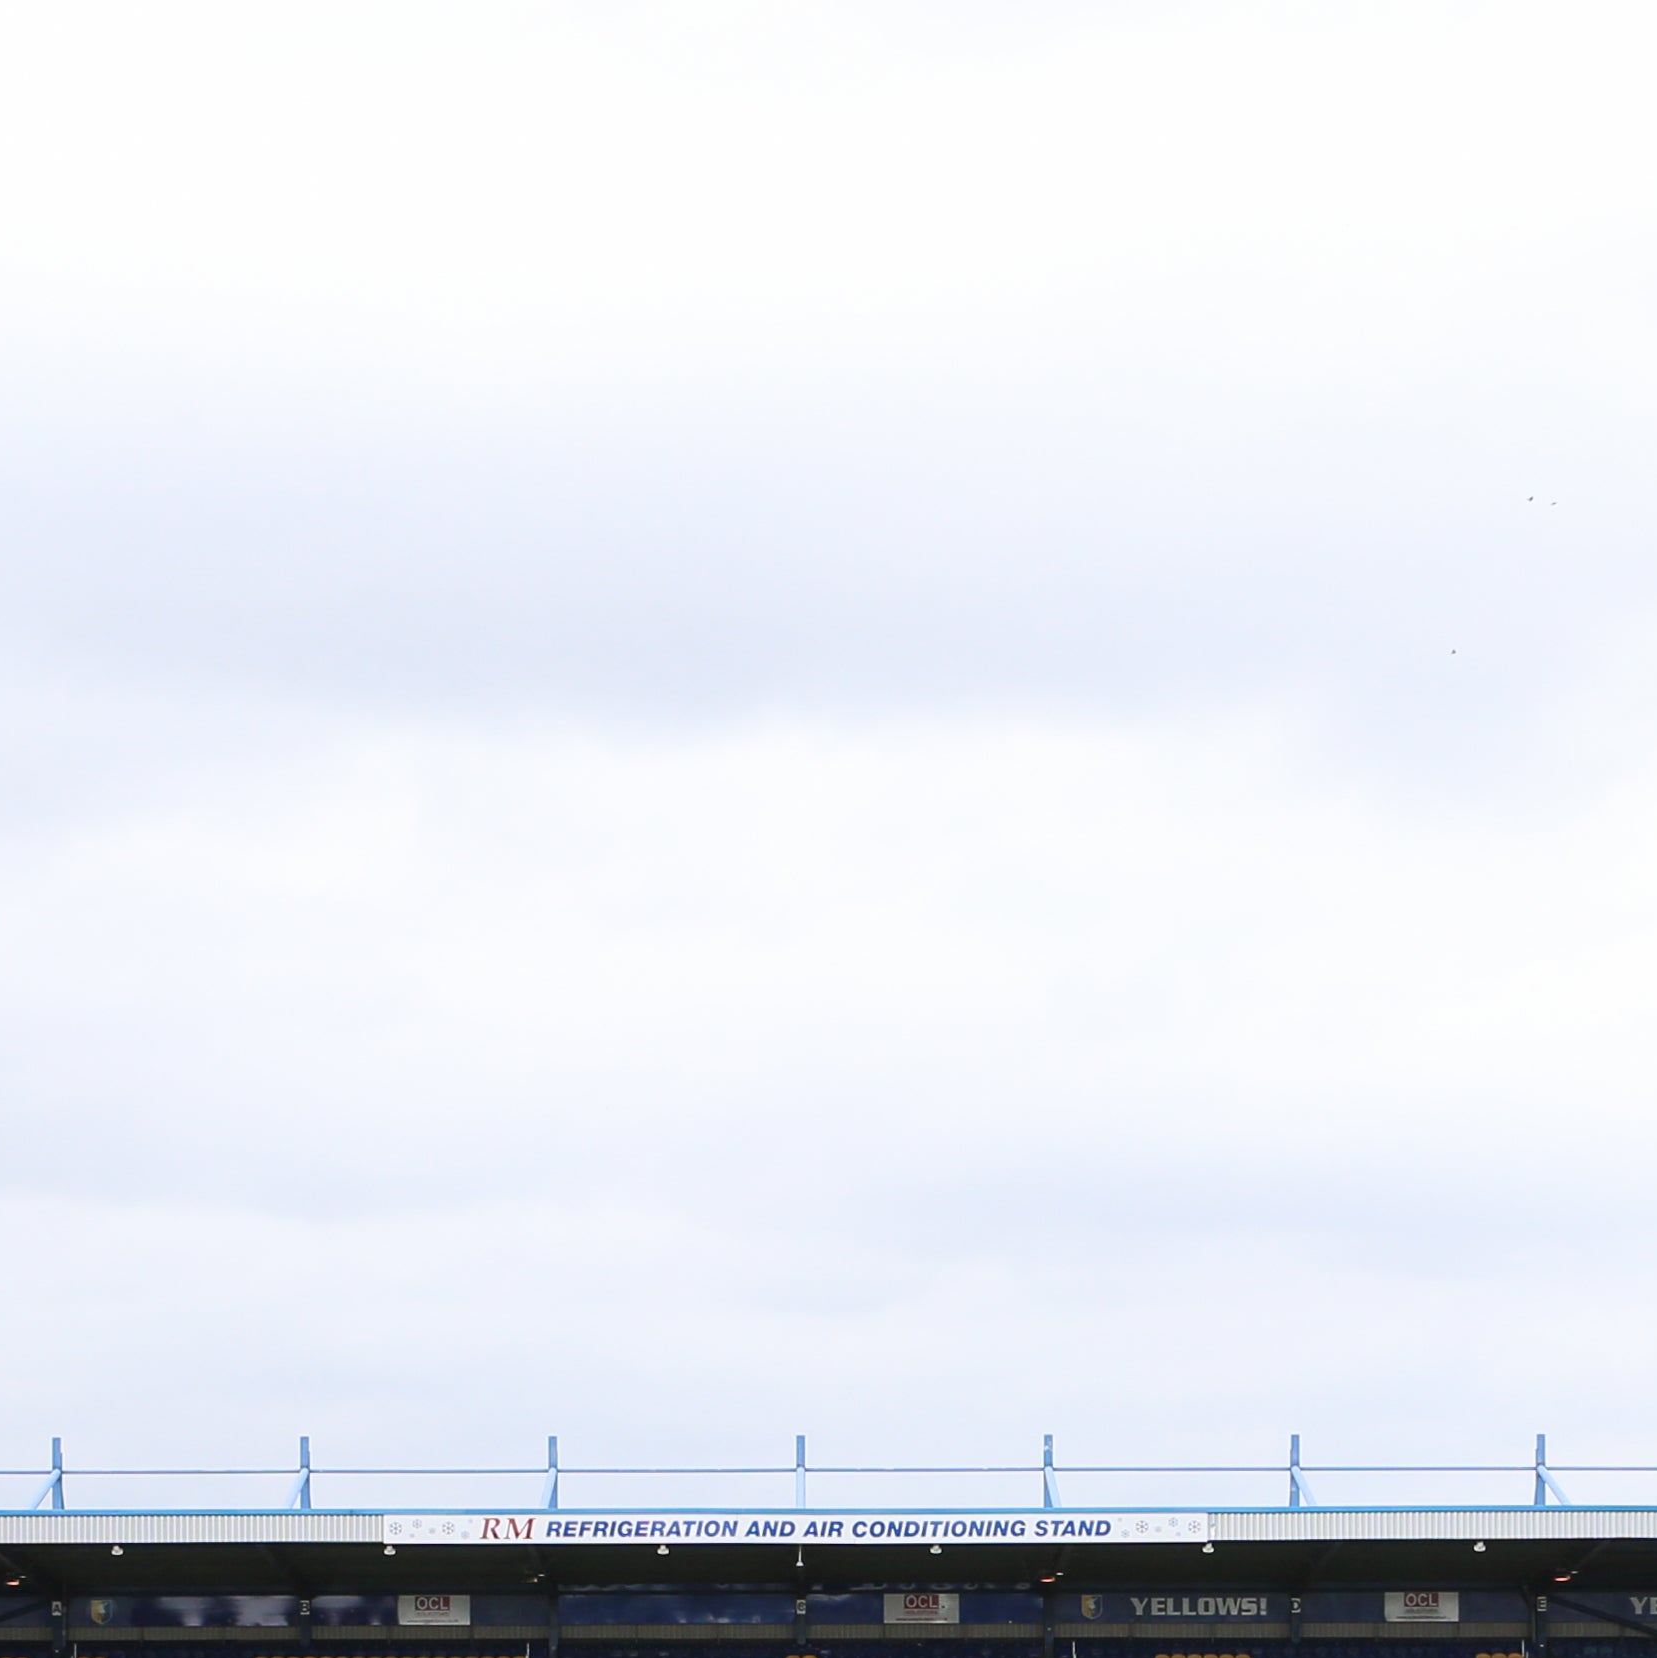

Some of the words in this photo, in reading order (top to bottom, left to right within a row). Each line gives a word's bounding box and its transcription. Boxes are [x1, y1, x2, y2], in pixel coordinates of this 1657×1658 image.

[480, 1518, 536, 1540] RM
[546, 1520, 738, 1538] REFRIGERATION
[745, 1520, 796, 1537] AND
[803, 1520, 844, 1538] AIR
[852, 1520, 1026, 1537] CONDITIONING
[1034, 1520, 1112, 1537] STAND
[1130, 1597, 1268, 1616] YELLOWS!
